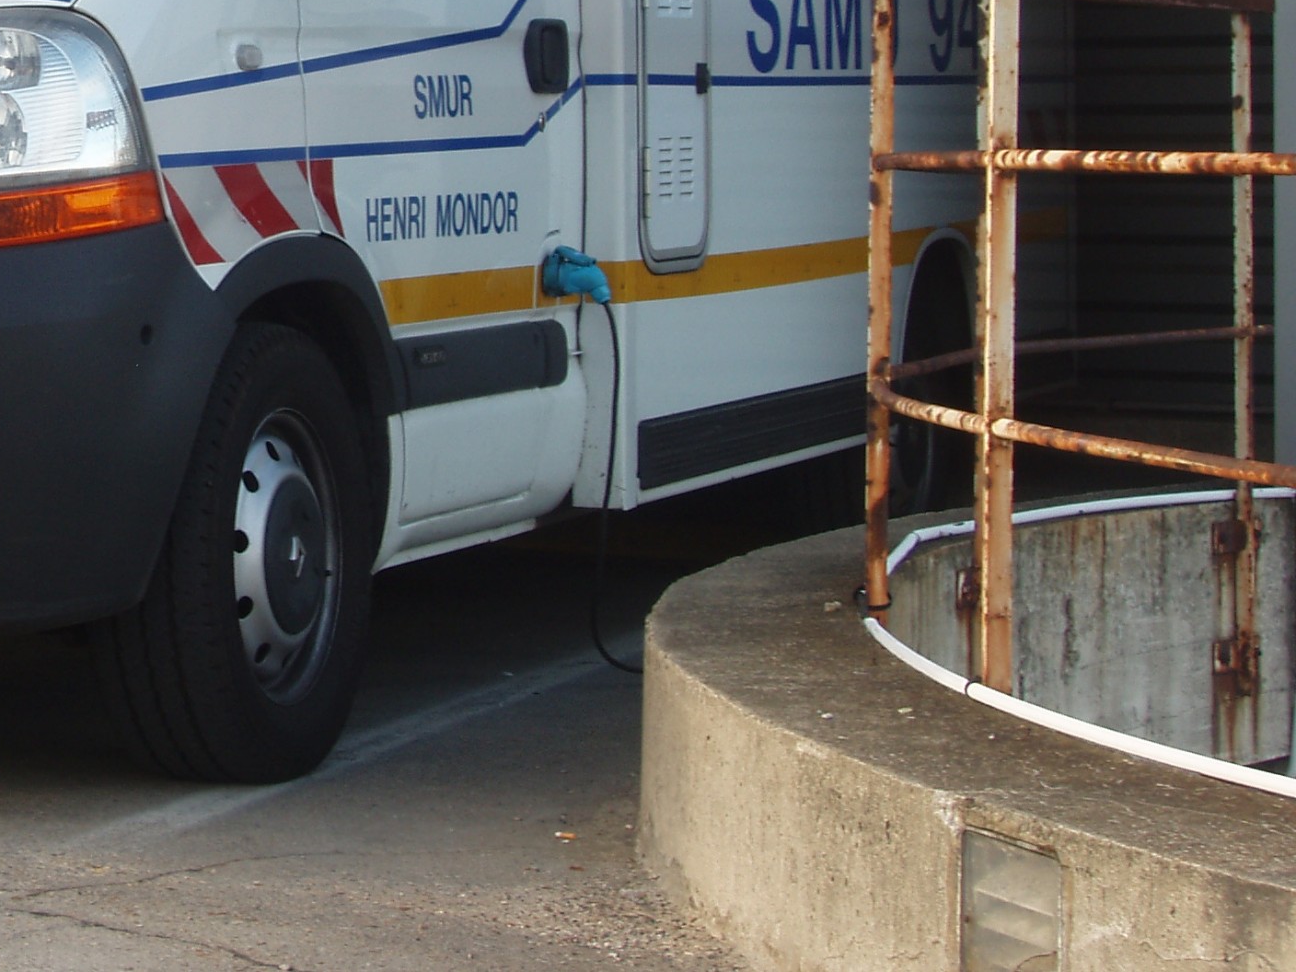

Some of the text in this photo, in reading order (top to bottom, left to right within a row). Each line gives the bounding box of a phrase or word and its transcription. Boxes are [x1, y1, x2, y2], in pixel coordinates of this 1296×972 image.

[413, 74, 473, 119] SMUR
[366, 191, 518, 242] HENRI MONDOR
